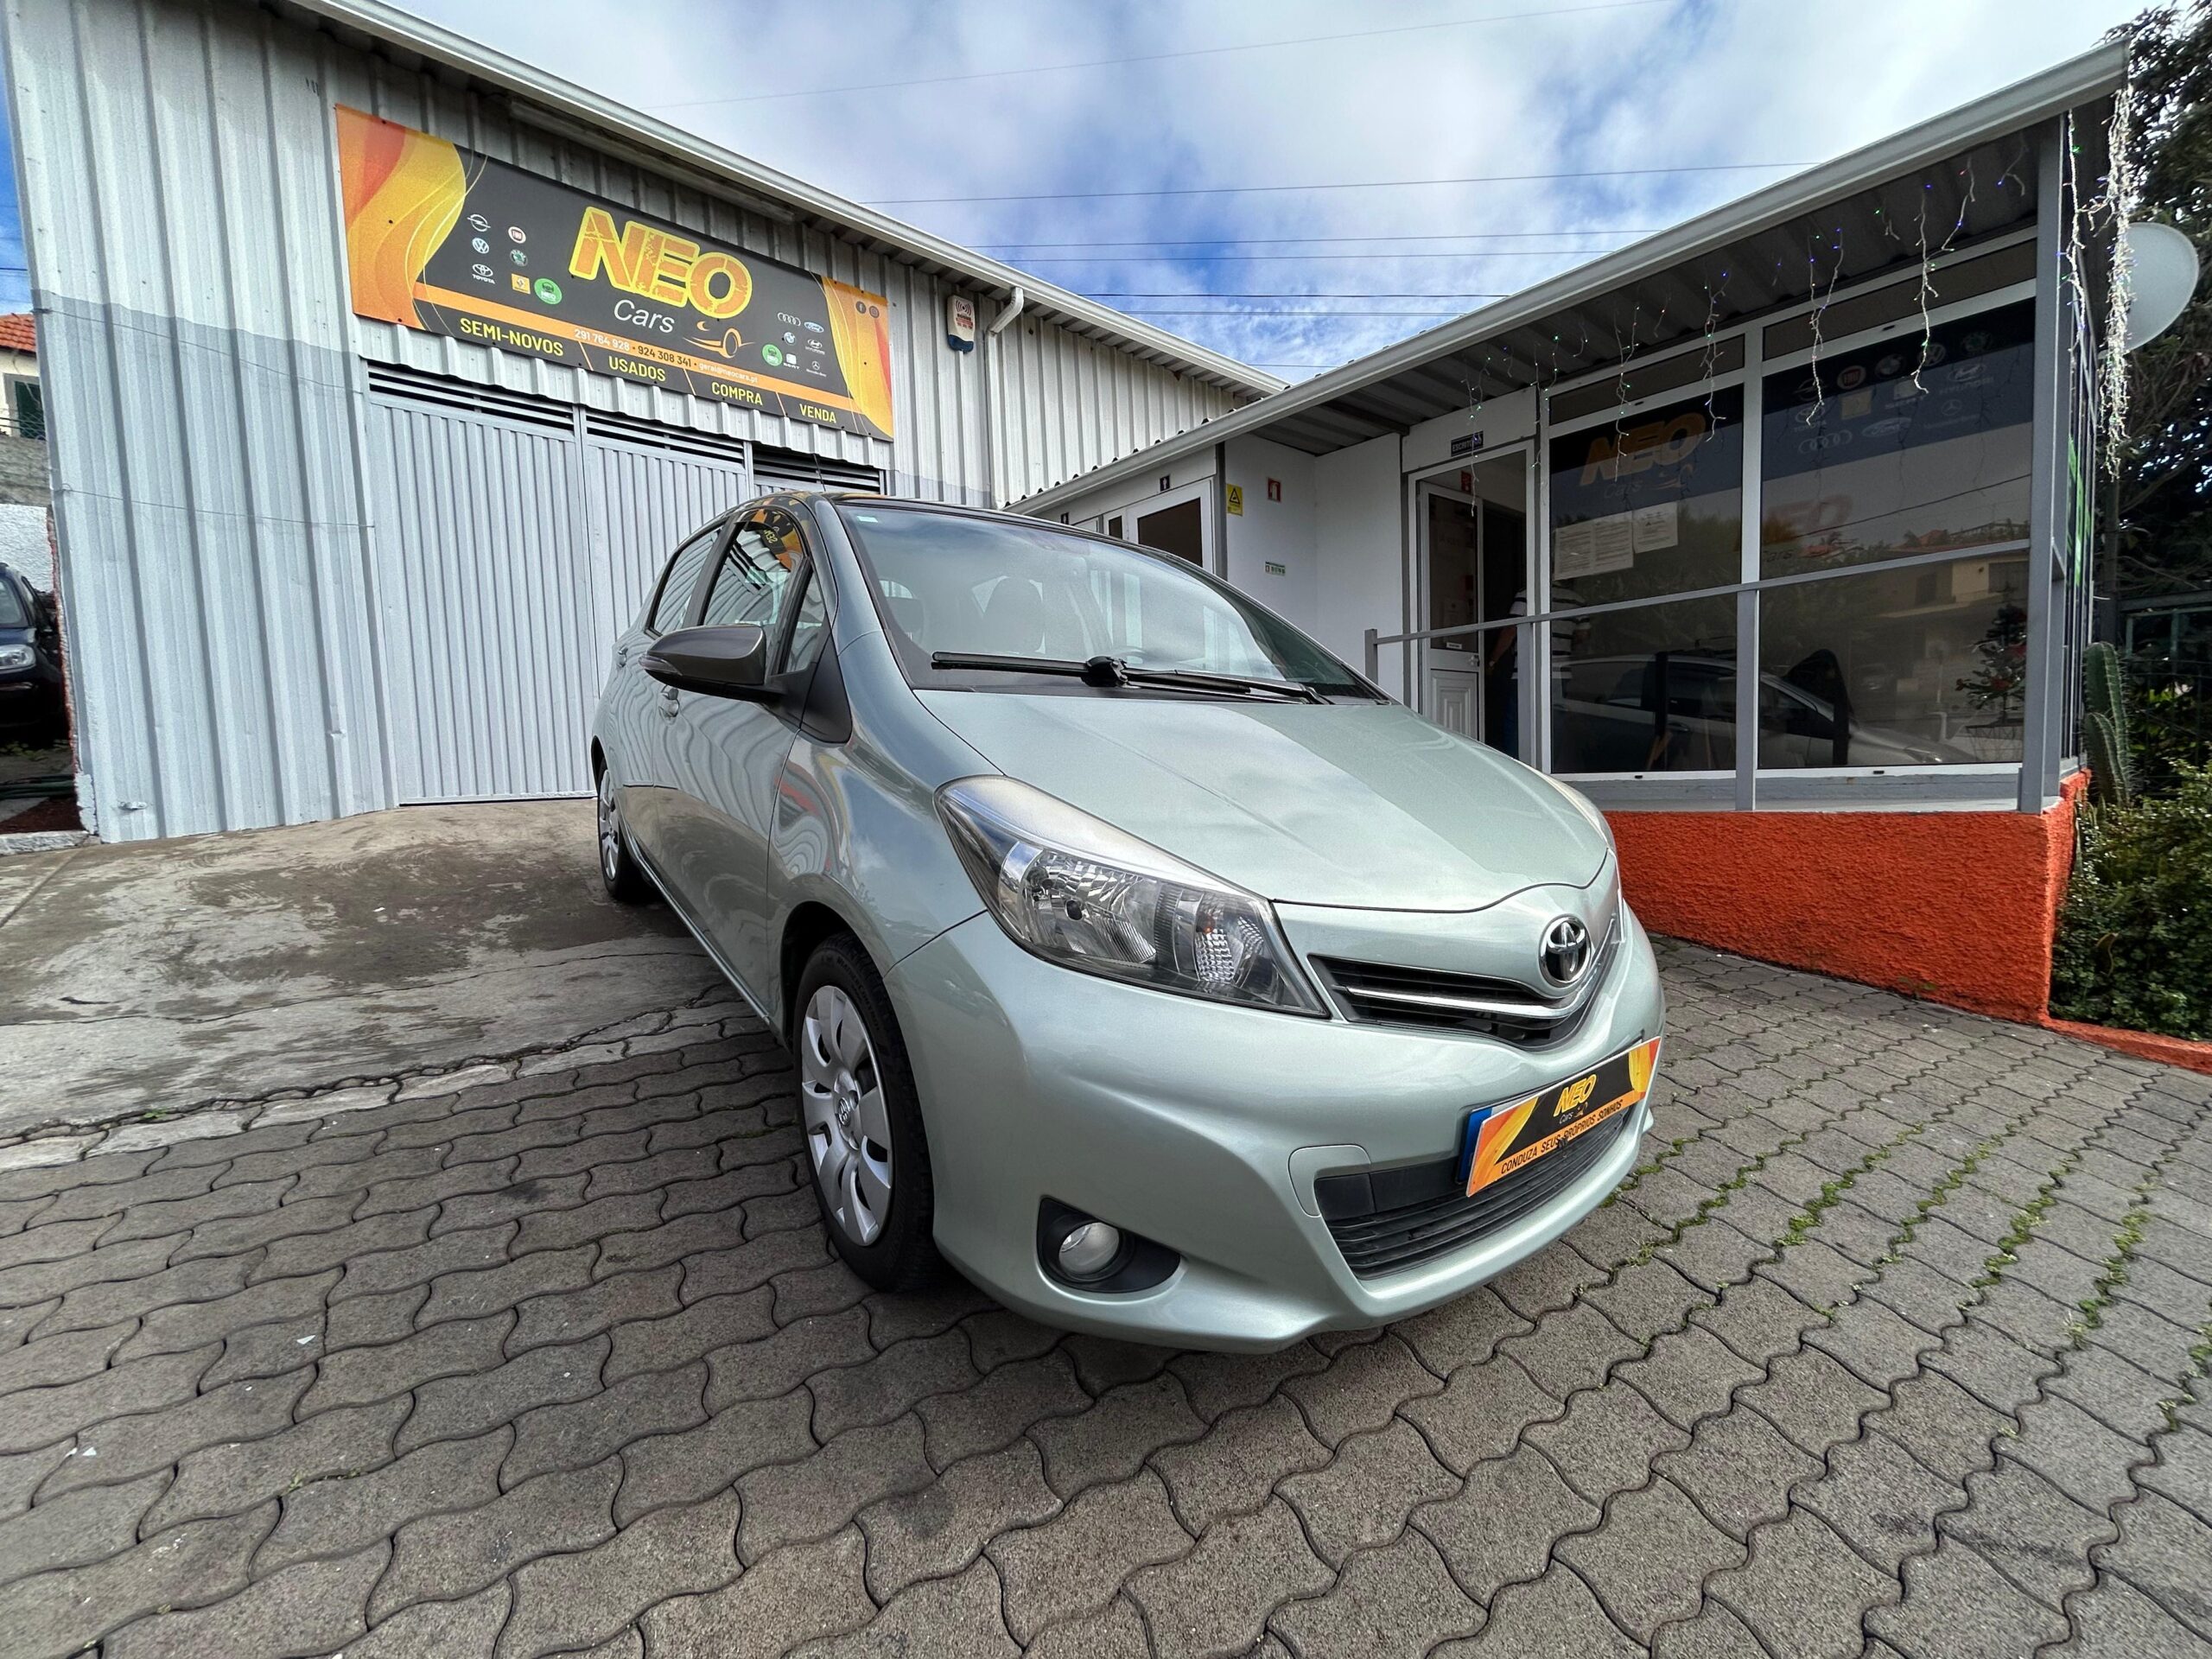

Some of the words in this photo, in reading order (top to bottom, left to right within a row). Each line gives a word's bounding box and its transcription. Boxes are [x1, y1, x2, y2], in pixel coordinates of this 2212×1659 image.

[472, 273, 496, 285] TOYOTA
[569, 206, 753, 319] NEO
[613, 299, 675, 334] Cars
[460, 317, 563, 357] SEMI-NOVOS
[574, 327, 591, 341] 291
[593, 333, 610, 347] 764
[612, 338, 630, 353] 928
[638, 345, 655, 359] 924
[658, 350, 675, 364] 308
[677, 355, 692, 368] 341
[608, 355, 666, 382] USADOS
[711, 381, 763, 406] COMPRA
[799, 403, 836, 423] VENDA
[1579, 412, 1707, 486] NEO
[1554, 1074, 1597, 1117] NEO
[1501, 1146, 1537, 1174] CONDUZA
